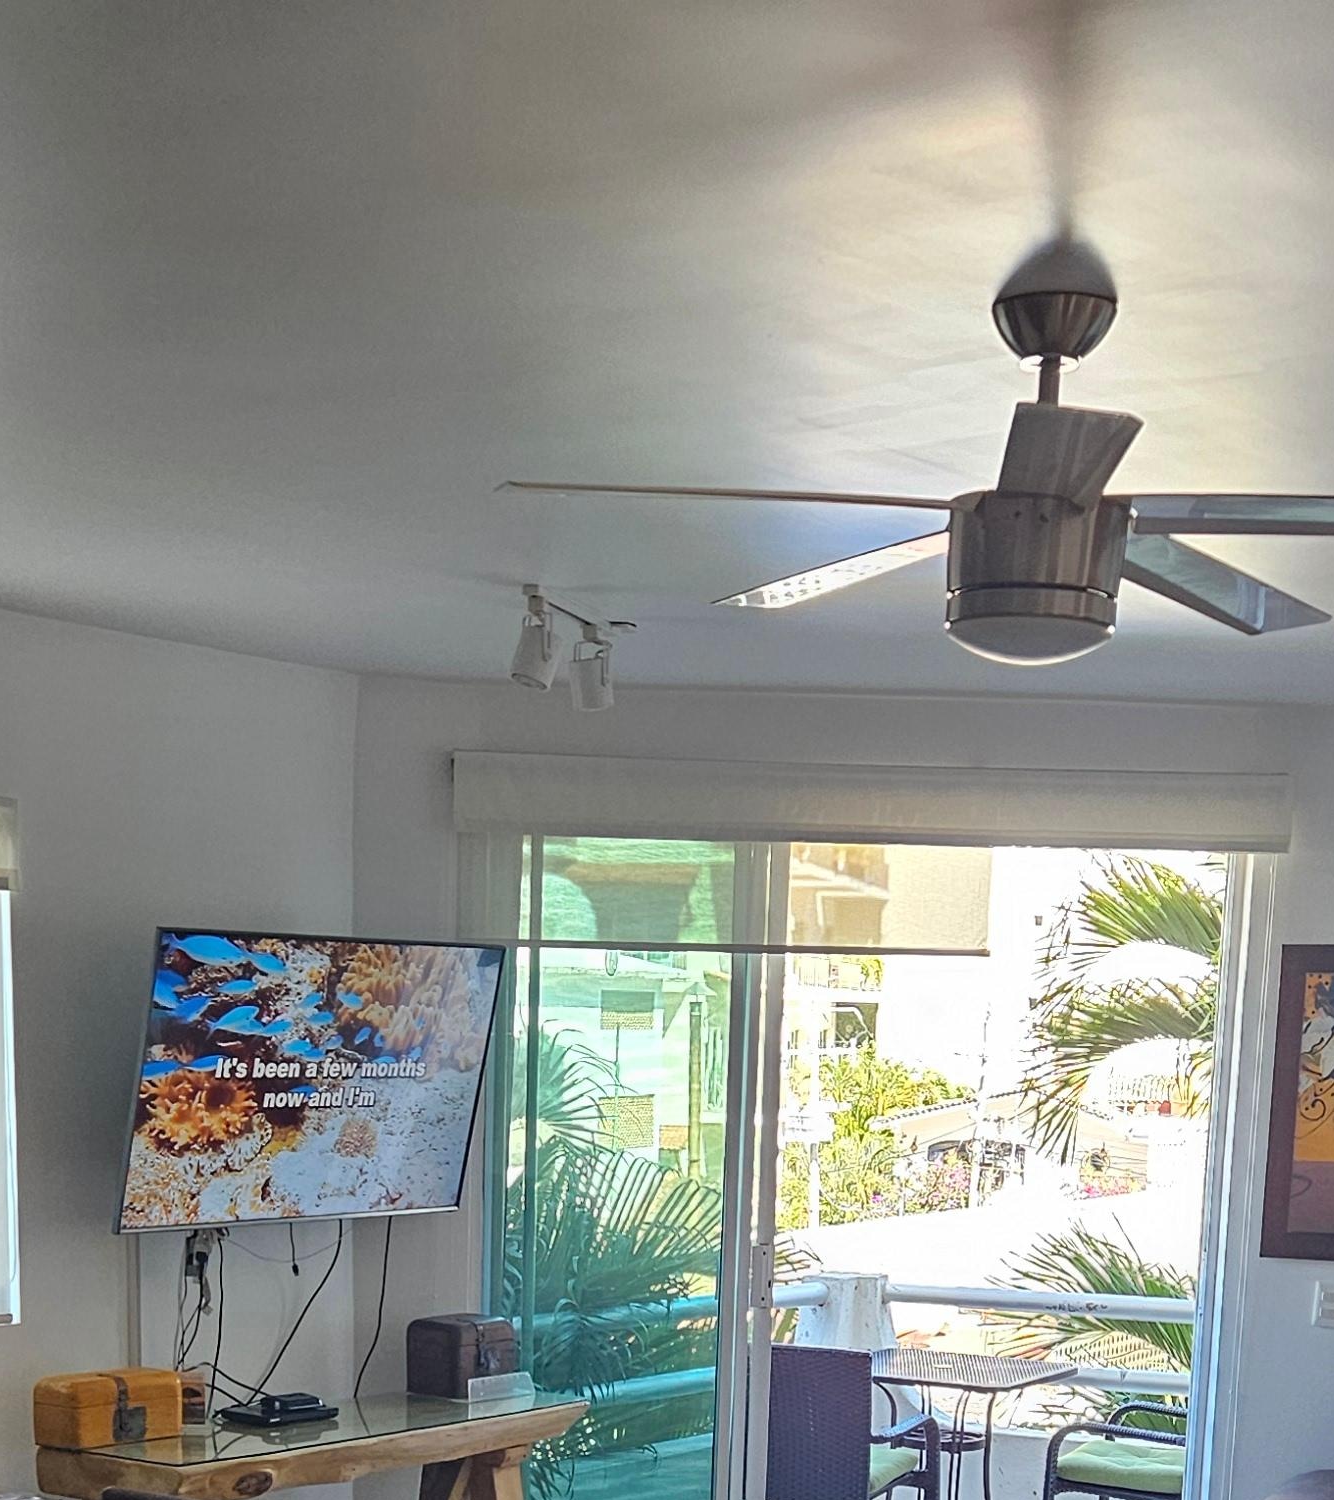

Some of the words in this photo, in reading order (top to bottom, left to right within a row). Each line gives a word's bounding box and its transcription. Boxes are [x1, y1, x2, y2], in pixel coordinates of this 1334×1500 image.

[215, 1058, 248, 1078] It's
[252, 1058, 301, 1078] been
[305, 1063, 317, 1078] a
[322, 1058, 357, 1078] few
[361, 1060, 426, 1078] months
[263, 1091, 305, 1108] now
[308, 1088, 343, 1107] and
[348, 1087, 376, 1106] I'm
